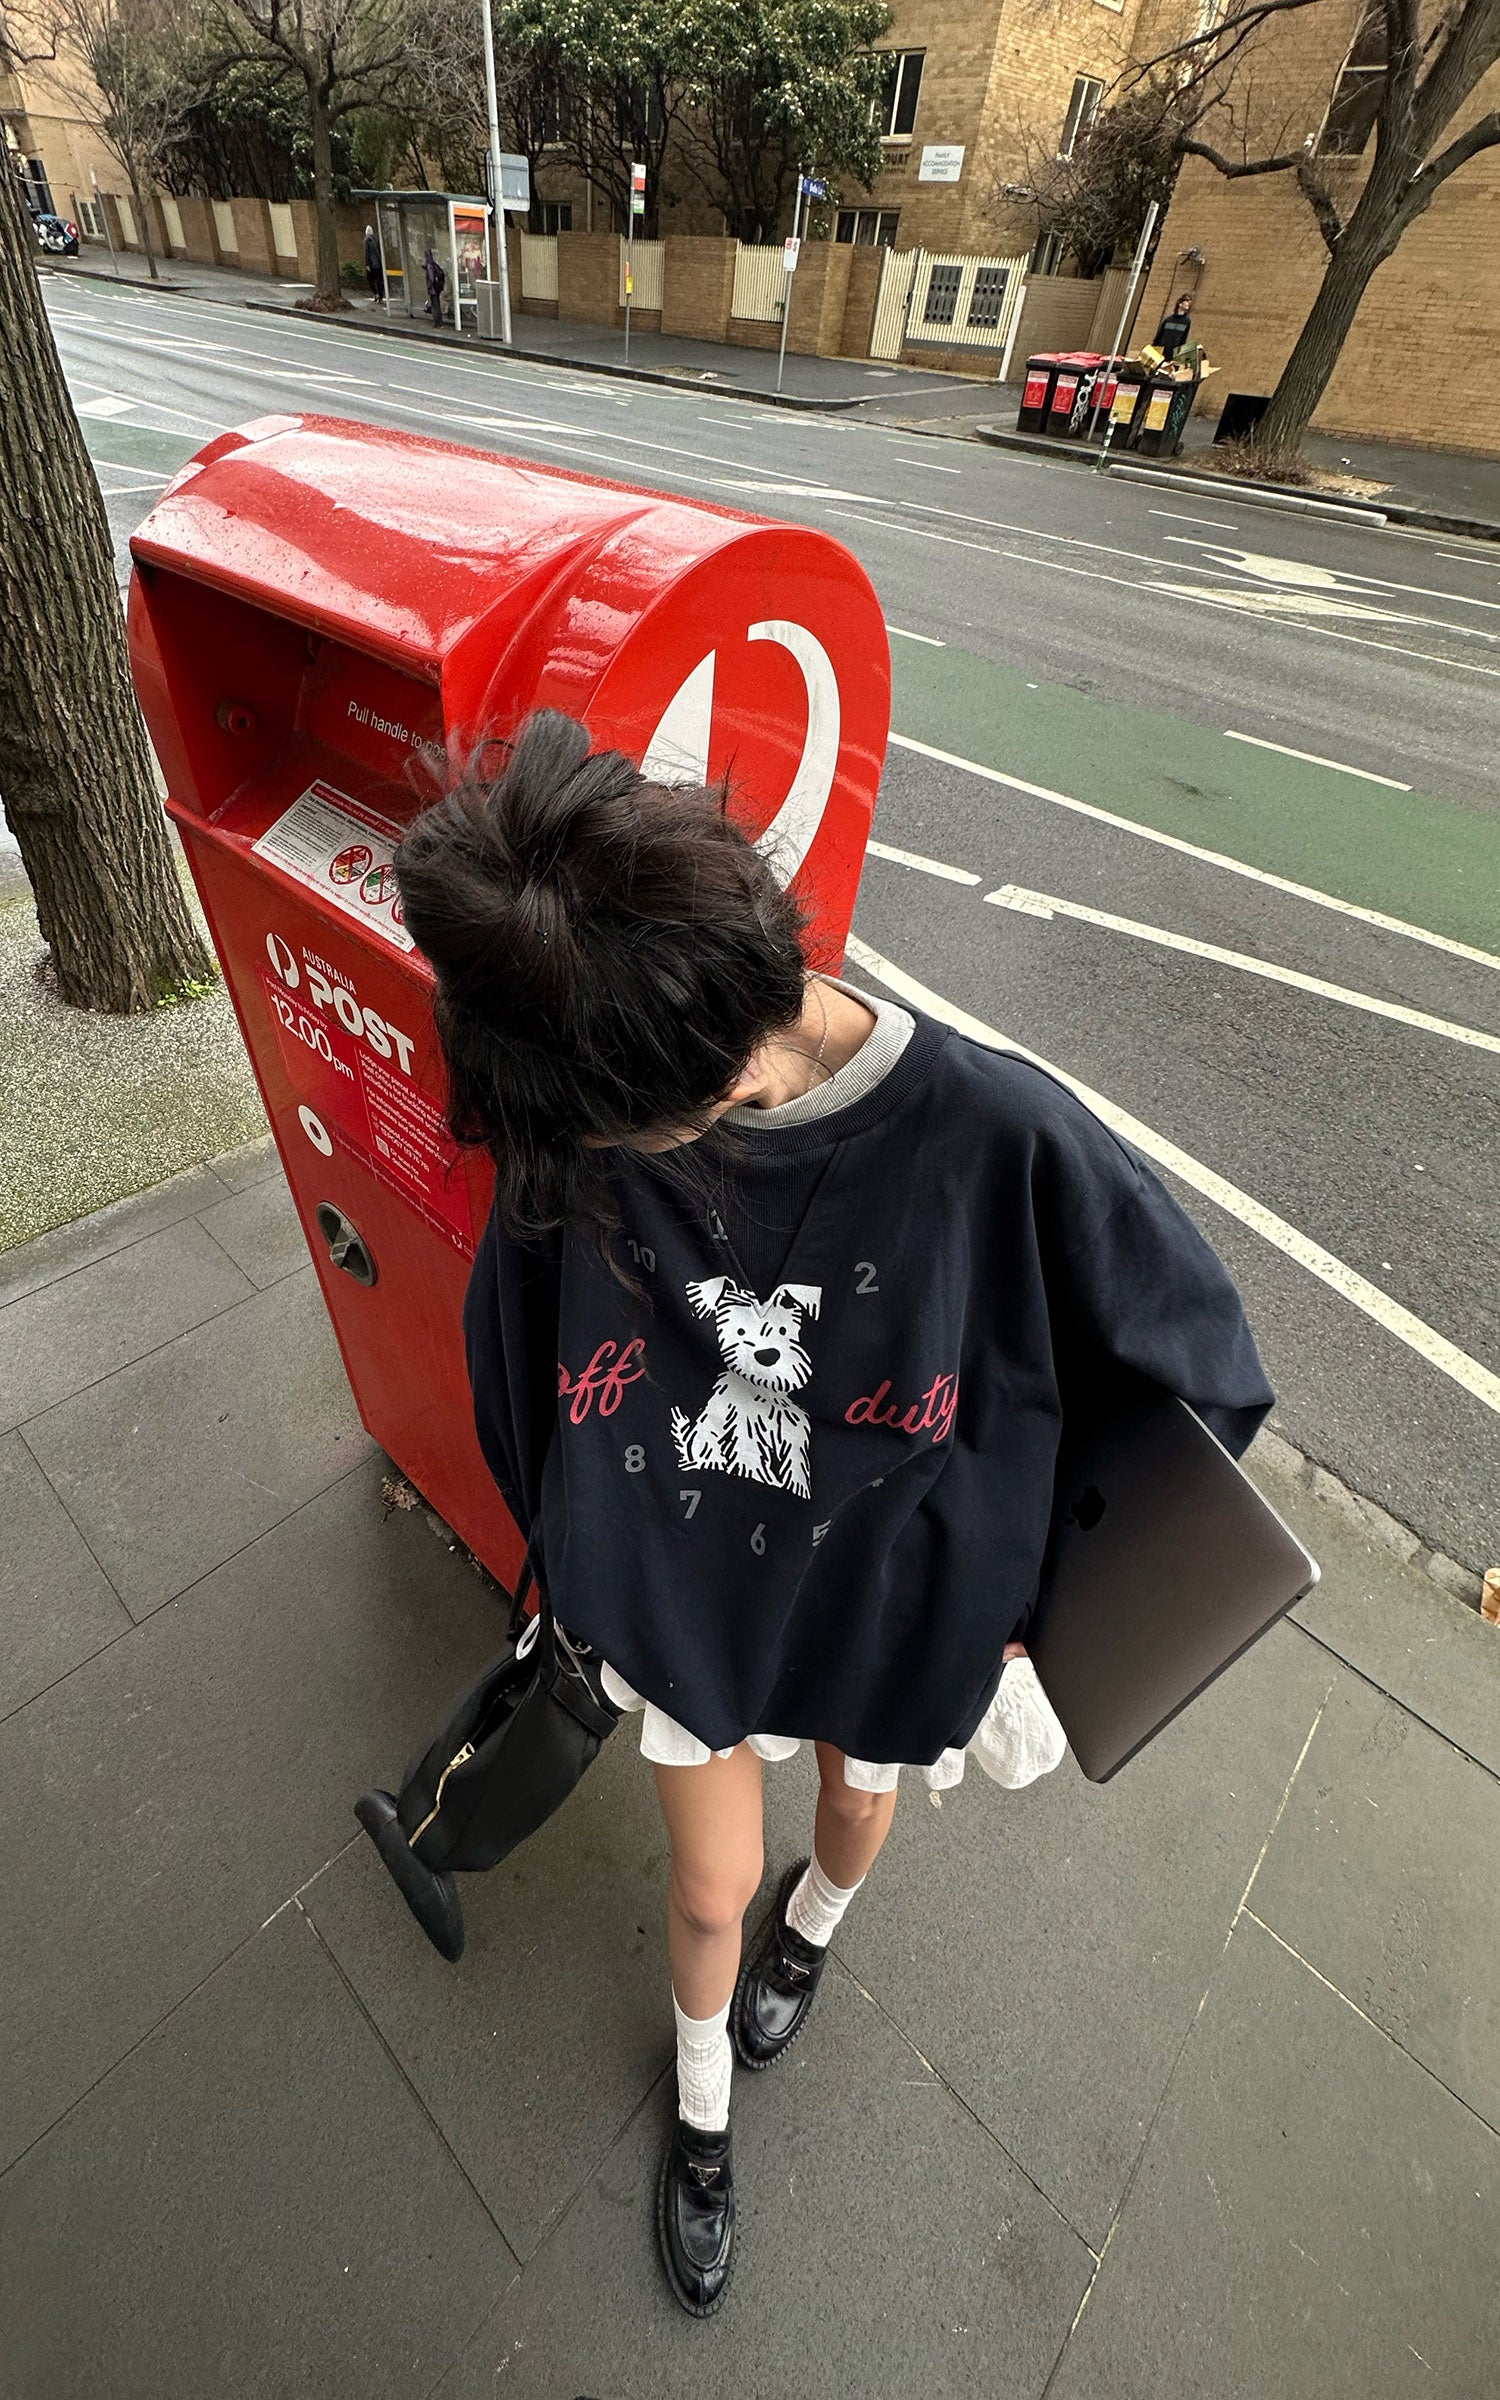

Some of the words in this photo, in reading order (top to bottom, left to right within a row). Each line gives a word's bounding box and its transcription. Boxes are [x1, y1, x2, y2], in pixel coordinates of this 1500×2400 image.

[347, 700, 369, 725] Pull
[370, 711, 409, 742] handle
[411, 731, 422, 749] to
[423, 741, 448, 761] pos
[302, 947, 357, 995] AUSTRALIA
[305, 964, 415, 1076] POST
[628, 1239, 656, 1273] 10
[854, 1261, 880, 1295] 2
[845, 1374, 959, 1443] duty
[624, 1444, 647, 1474] 8
[679, 1489, 702, 1520] 7
[750, 1522, 767, 1556] 6
